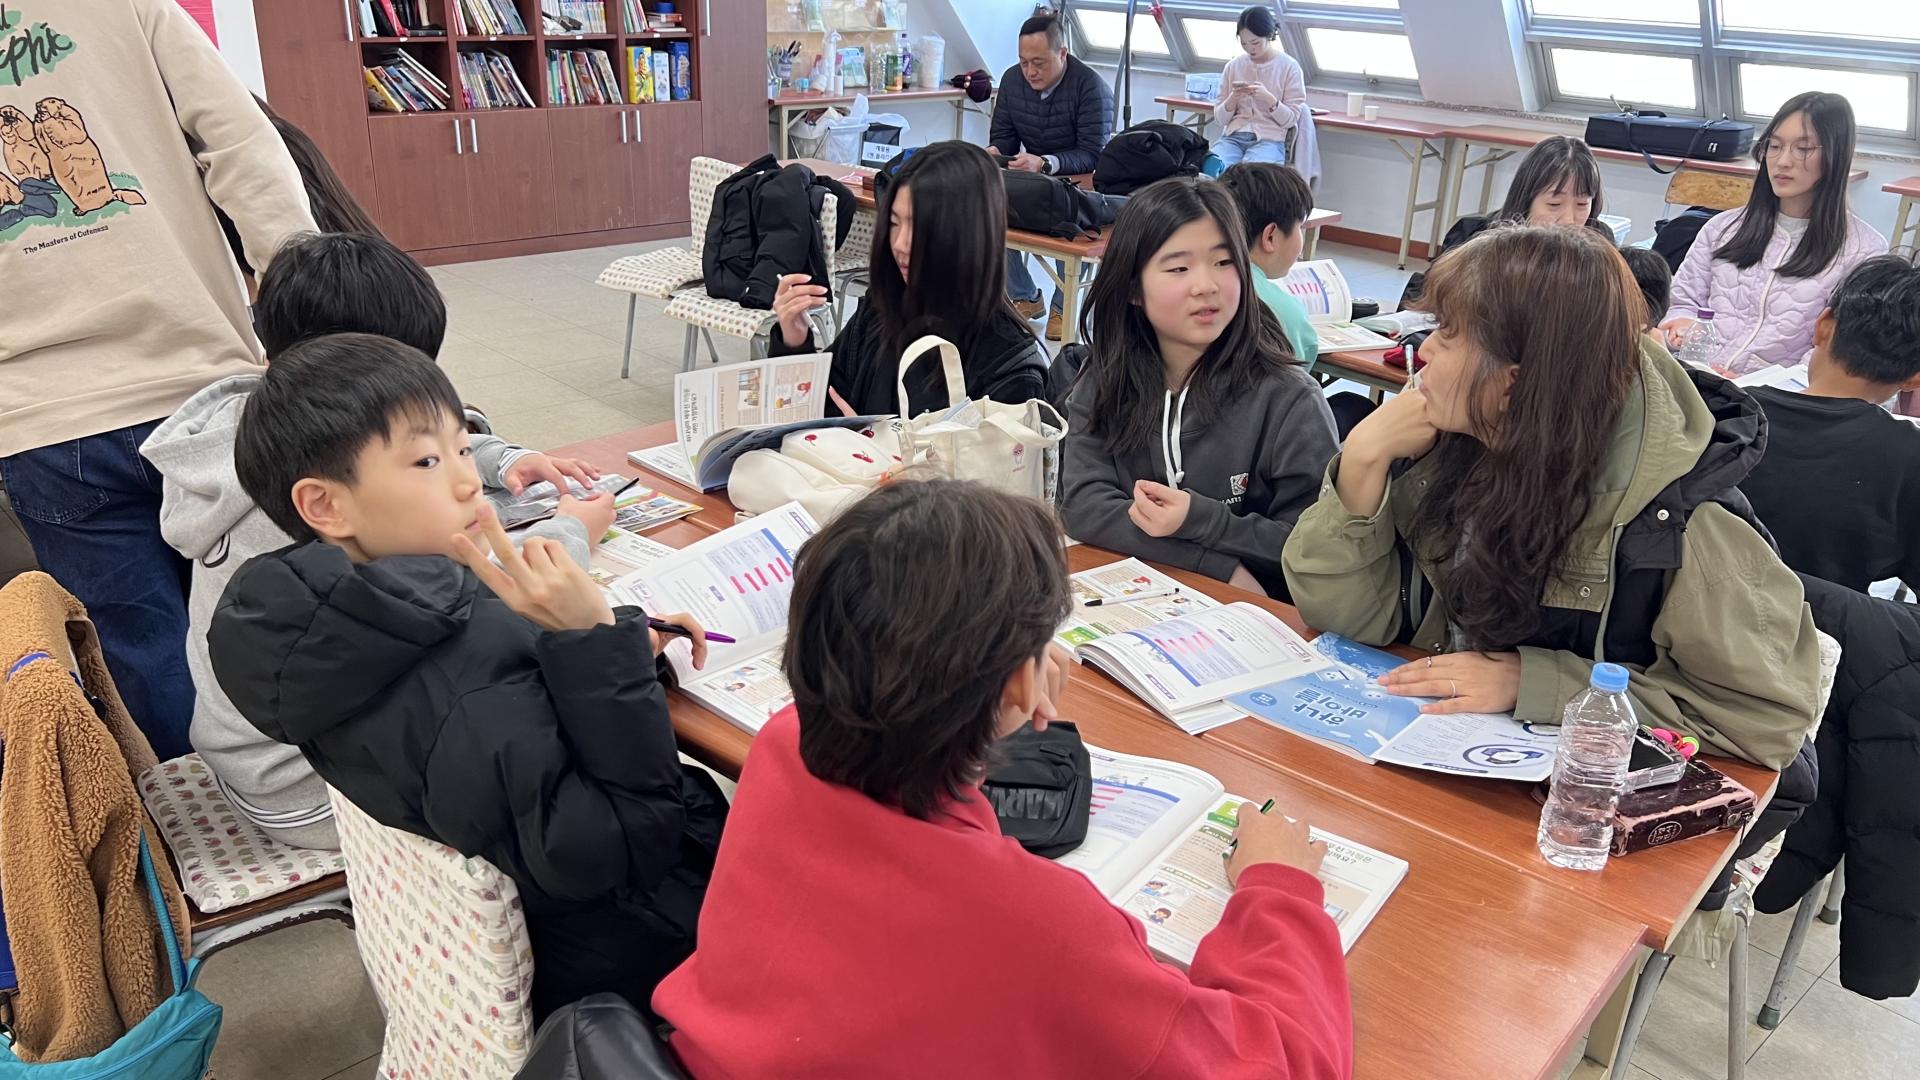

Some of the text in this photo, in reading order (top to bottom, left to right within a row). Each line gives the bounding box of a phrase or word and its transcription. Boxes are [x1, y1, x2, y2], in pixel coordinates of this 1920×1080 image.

[22, 246, 38, 255] The
[39, 237, 69, 250] Masters
[77, 225, 109, 238] Cuteness
[1294, 688, 1368, 718] 바이블
[1294, 704, 1346, 725] 하나
